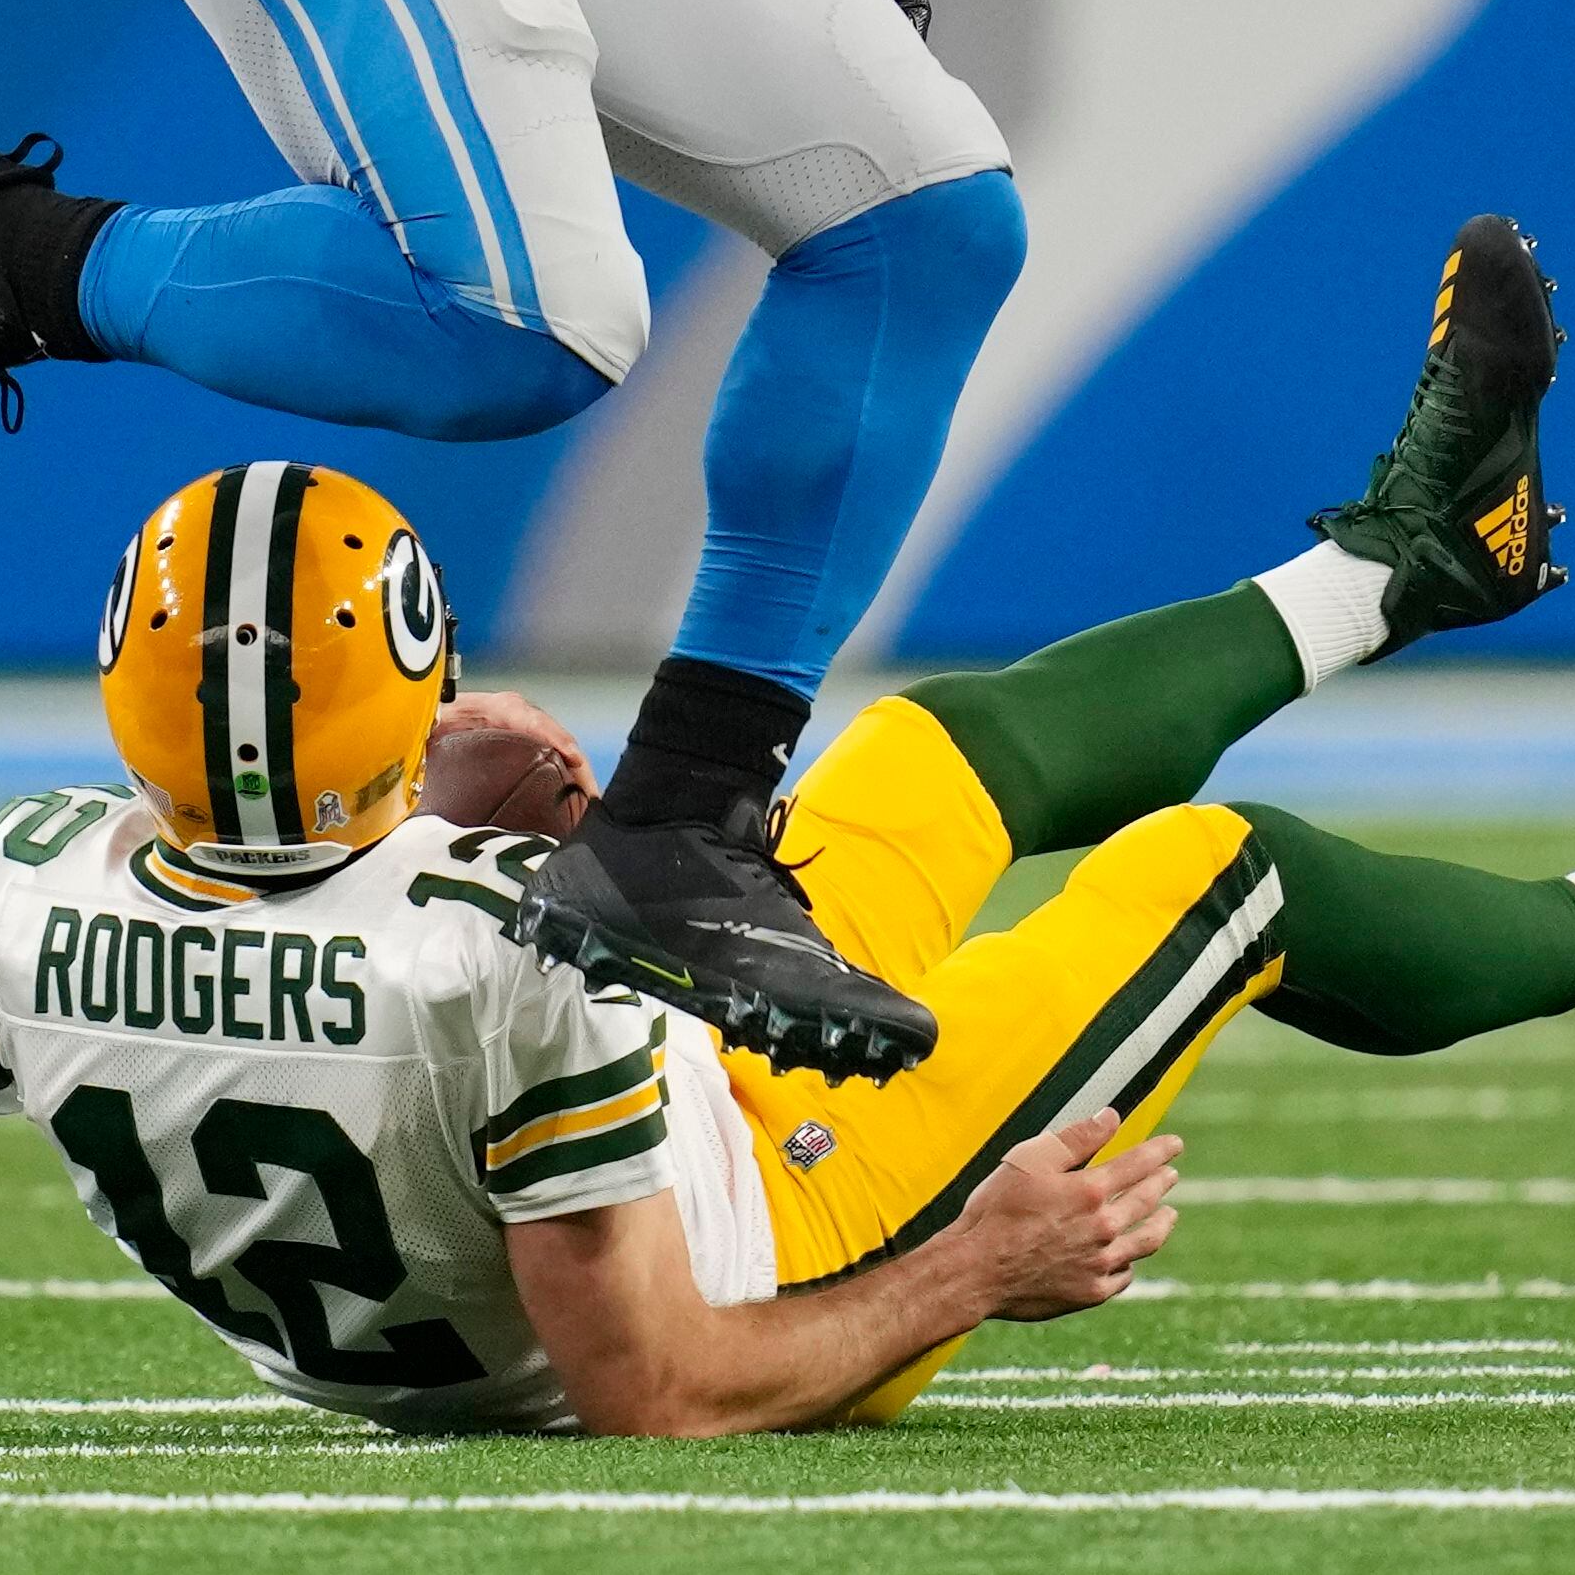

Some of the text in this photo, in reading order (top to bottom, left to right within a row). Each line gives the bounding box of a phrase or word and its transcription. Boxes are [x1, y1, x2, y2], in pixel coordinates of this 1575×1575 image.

[1508, 474, 1529, 576] adidas
[214, 849, 311, 866] PACKERS
[33, 906, 366, 1046] RODGERS
[50, 1082, 489, 1391] 12
